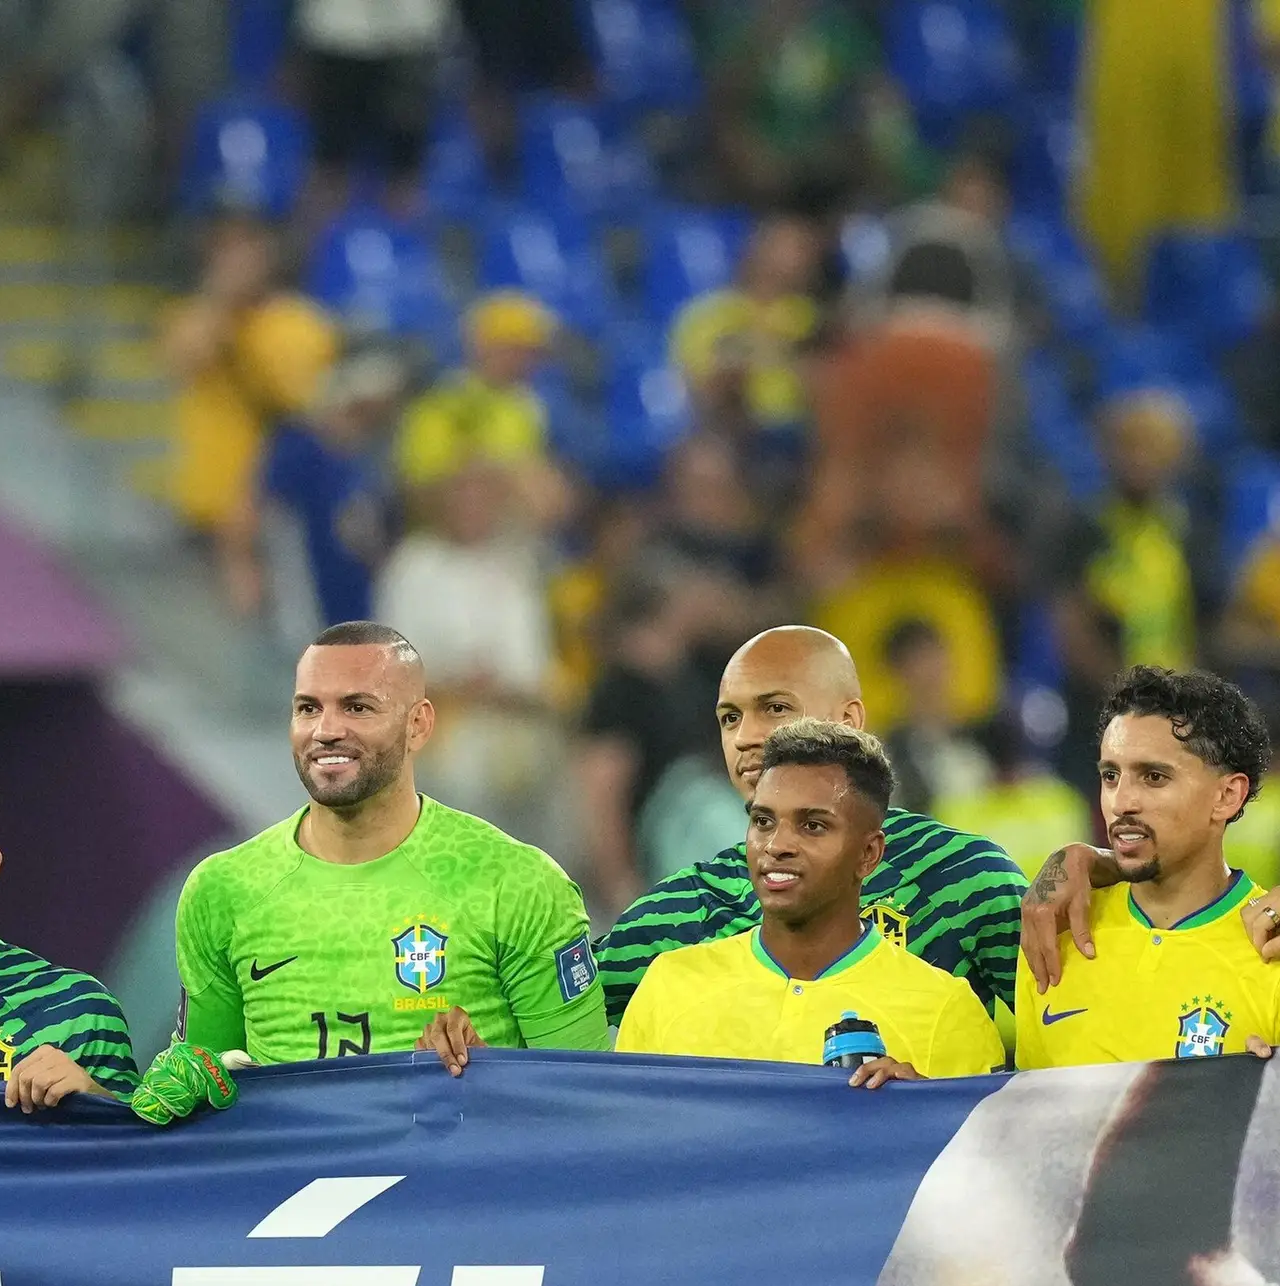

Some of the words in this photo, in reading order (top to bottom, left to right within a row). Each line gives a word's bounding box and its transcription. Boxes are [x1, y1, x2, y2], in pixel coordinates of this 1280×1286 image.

[410, 952, 430, 962] CBF
[394, 996, 450, 1012] BRASIL
[1190, 1034, 1210, 1045] CBF
